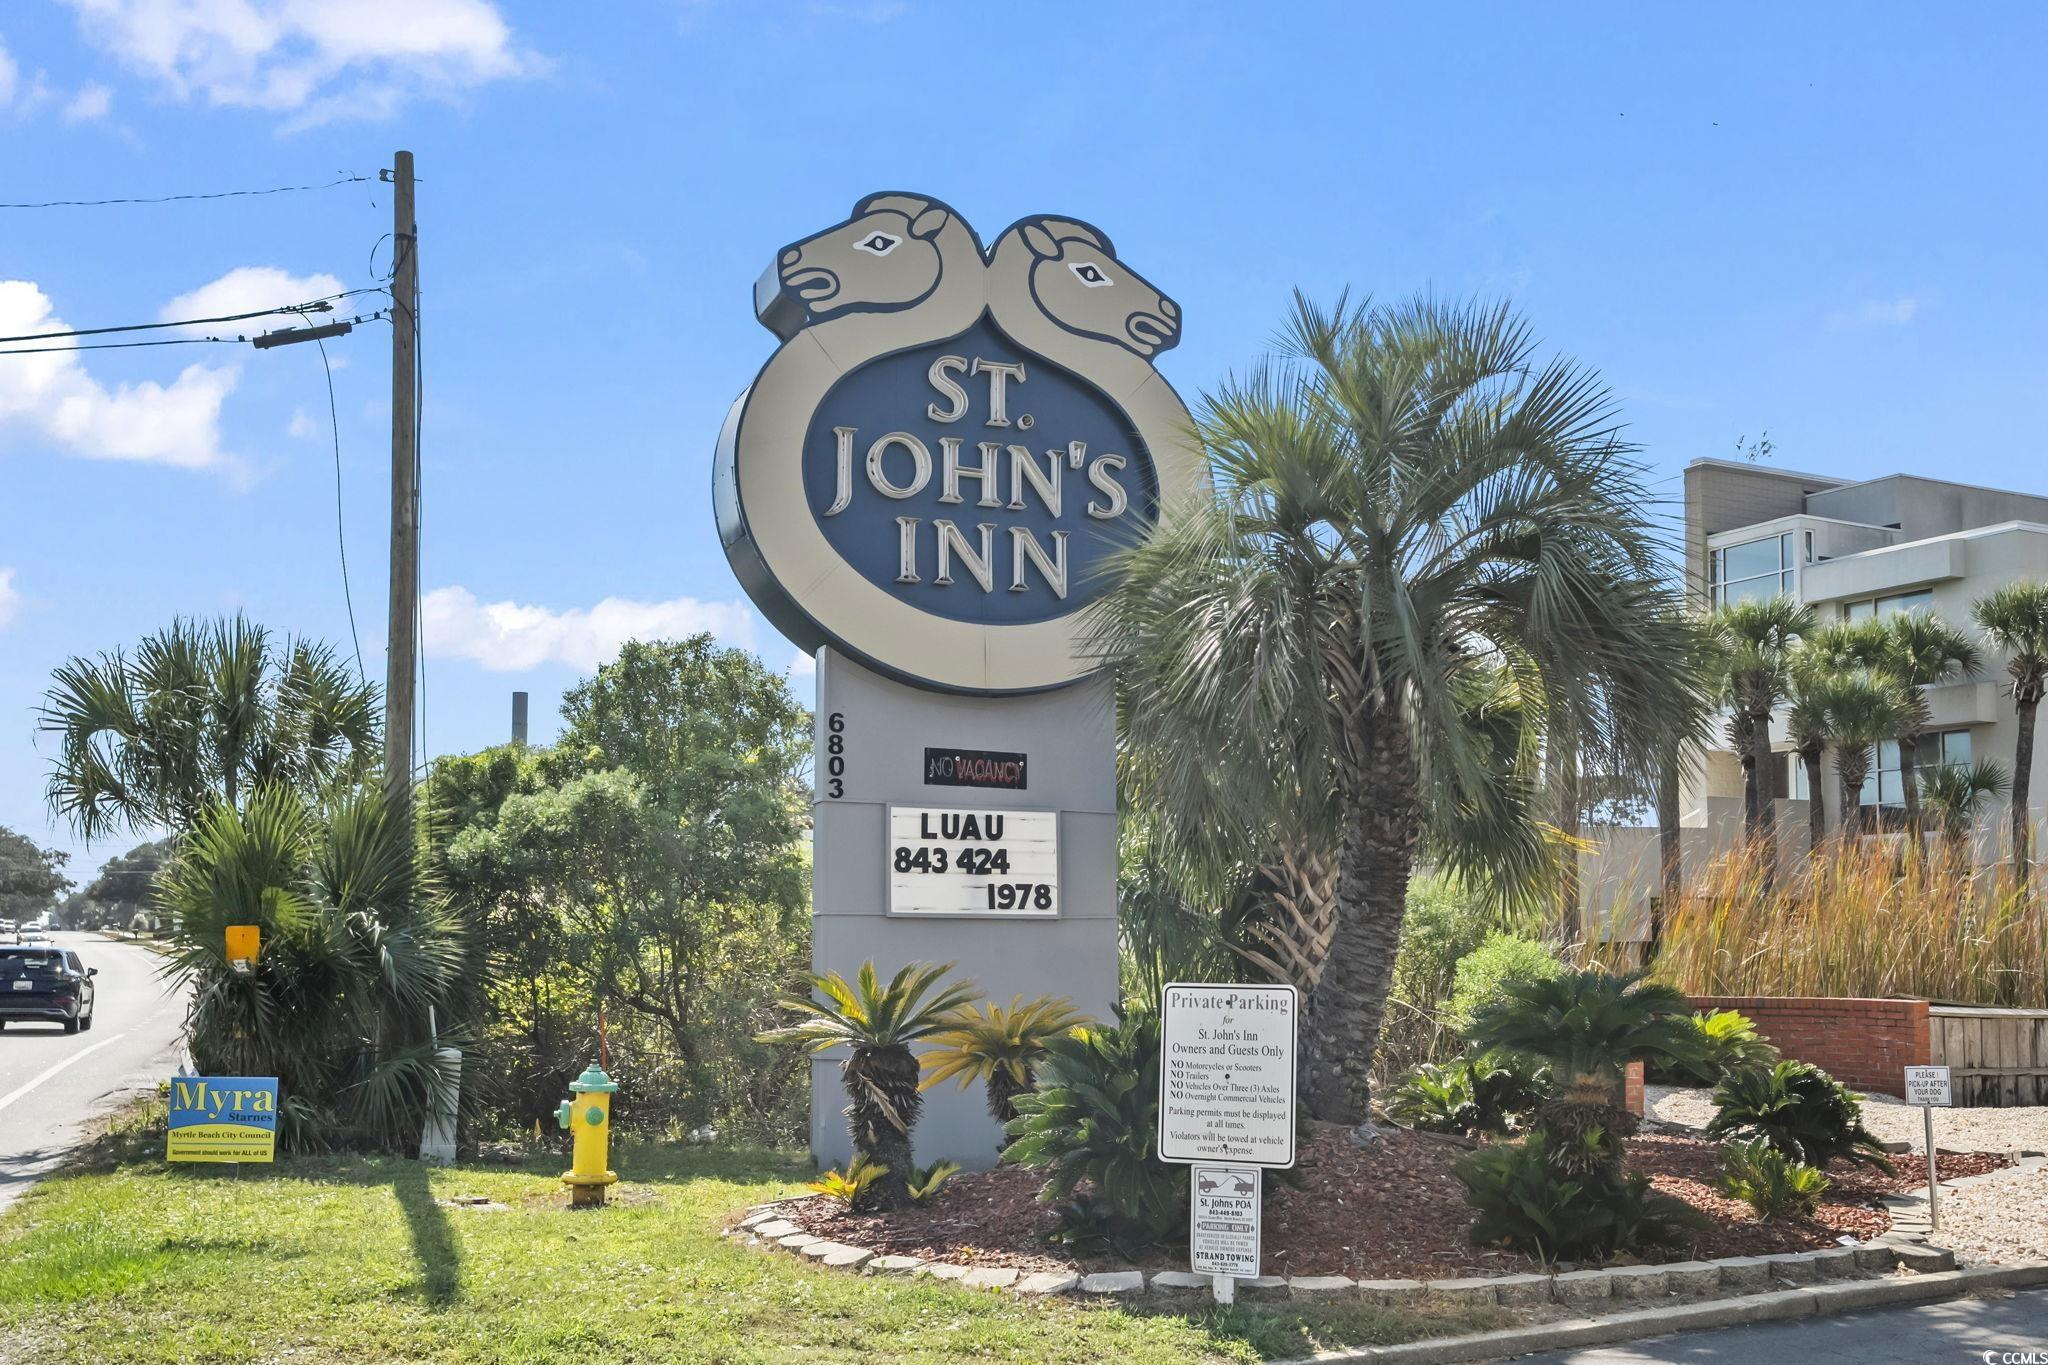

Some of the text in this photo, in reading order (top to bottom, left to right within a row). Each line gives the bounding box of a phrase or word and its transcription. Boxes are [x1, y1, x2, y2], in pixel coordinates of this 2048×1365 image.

[927, 355, 1034, 430] ST.
[823, 426, 1127, 519] JOHN'S
[896, 517, 1070, 600] INN
[828, 712, 845, 799] 6803
[929, 757, 1023, 784] NO VACANCY
[921, 813, 1004, 841] LUAU
[894, 847, 1010, 875] 843 424
[987, 883, 1052, 910] 1978
[1171, 992, 1288, 1015] Private Parking
[1222, 1015, 1234, 1024] for
[1198, 1029, 1258, 1041] St. John's Inn
[1172, 1043, 1284, 1059] Owners and Guests Only
[1171, 1060, 1184, 1069] NO
[1185, 1061, 1224, 1072] Motorcycles
[1235, 1063, 1262, 1072] Scooters
[1171, 1070, 1209, 1080] NO Trailers
[1170, 1080, 1280, 1094] NO Vehicles Over Three (3) Axles
[173, 1082, 275, 1119] Myra
[1170, 1090, 1286, 1104] NO Overnight Commercial Vehicles
[228, 1112, 273, 1122] Starnes
[1168, 1106, 1286, 1121] Parking permits must be displayed
[1214, 1120, 1224, 1129] all
[1225, 1121, 1246, 1129] times.
[172, 1131, 196, 1139] Myrtle
[221, 1131, 238, 1140] City
[1170, 1131, 1284, 1145] Violators will be towed at vehicle
[1197, 1145, 1255, 1155] owner's expense.
[1200, 1198, 1252, 1209] St. Johns POA
[1202, 1222, 1229, 1230] PARKING
[1196, 1251, 1255, 1263] STRAND TOWING
